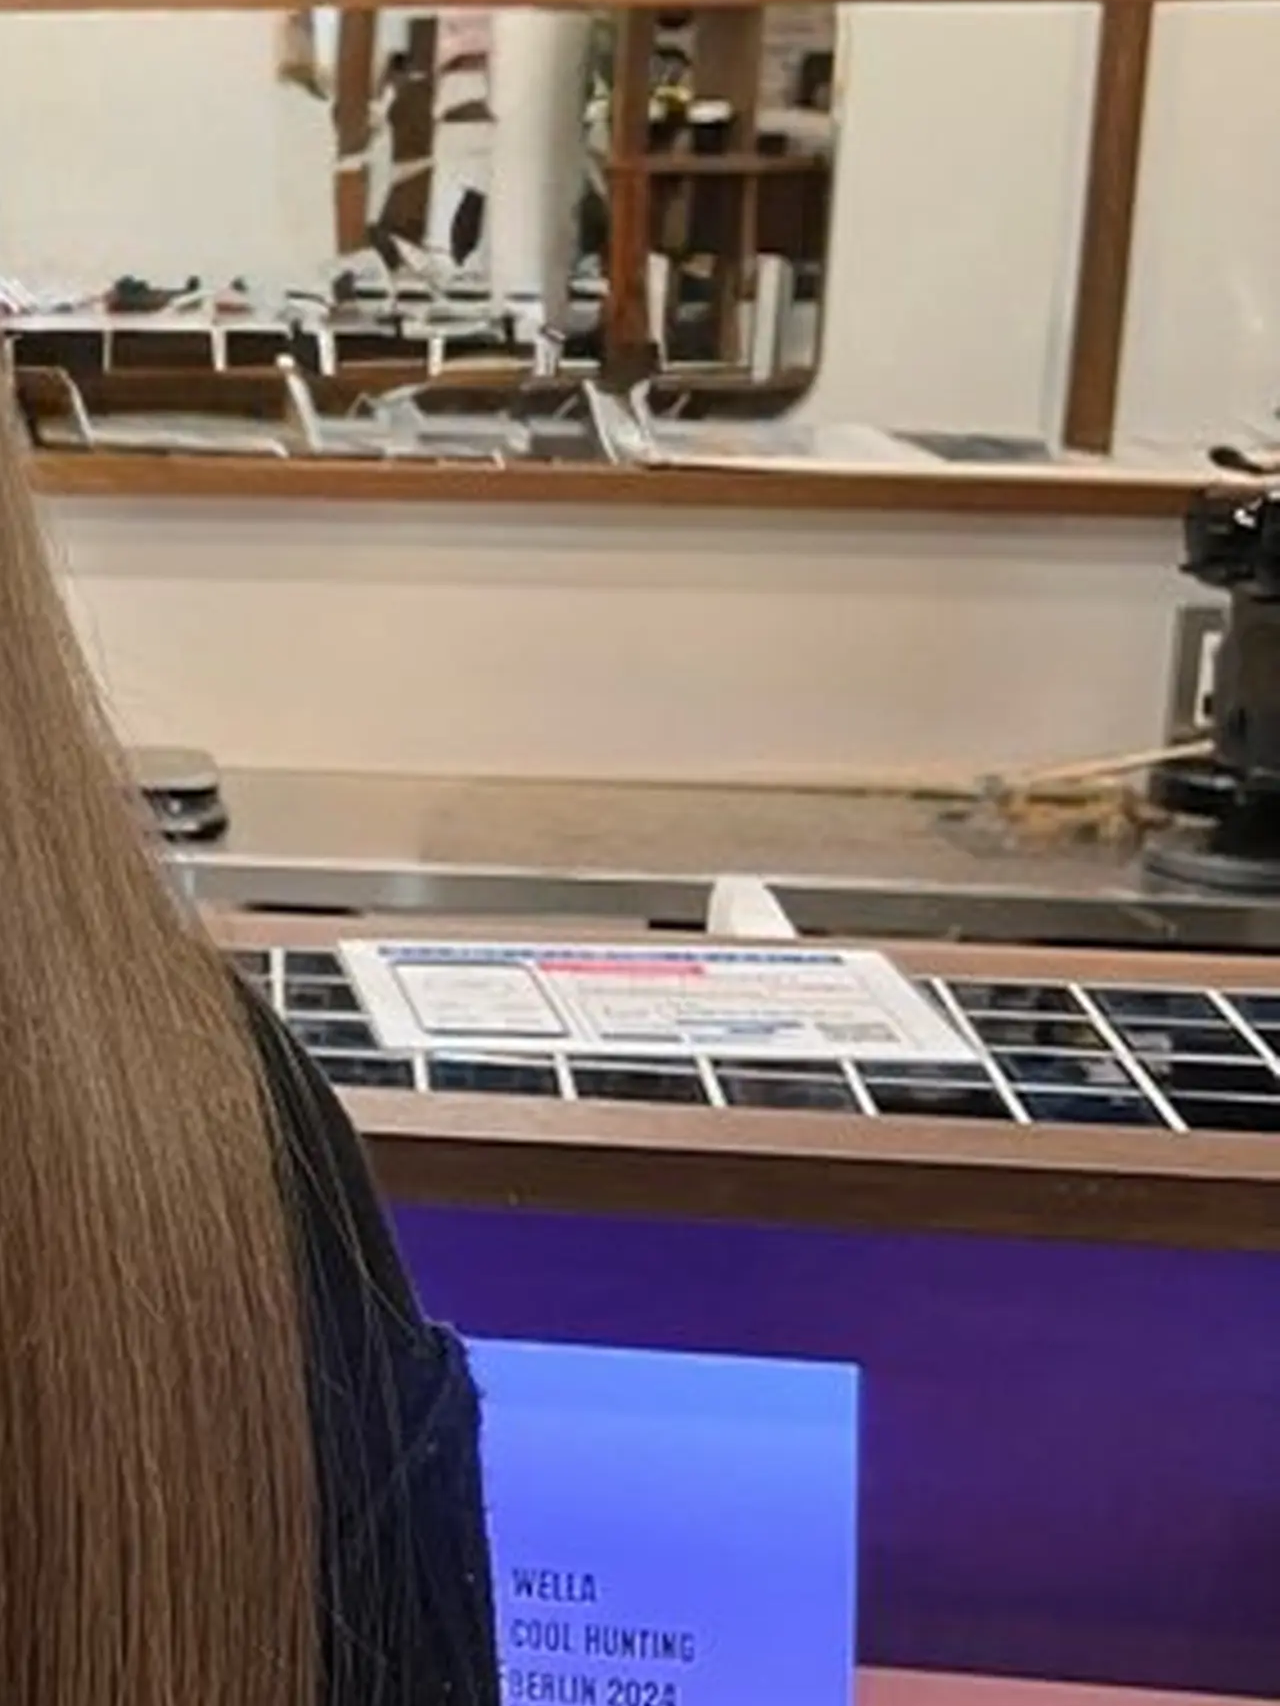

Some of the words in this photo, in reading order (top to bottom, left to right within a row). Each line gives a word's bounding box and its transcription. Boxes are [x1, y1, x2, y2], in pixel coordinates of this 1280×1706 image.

[512, 1568, 597, 1602] WELLA
[510, 1618, 572, 1653] COOL
[584, 1624, 696, 1663] HUNTING
[508, 1668, 597, 1706] BERLIN
